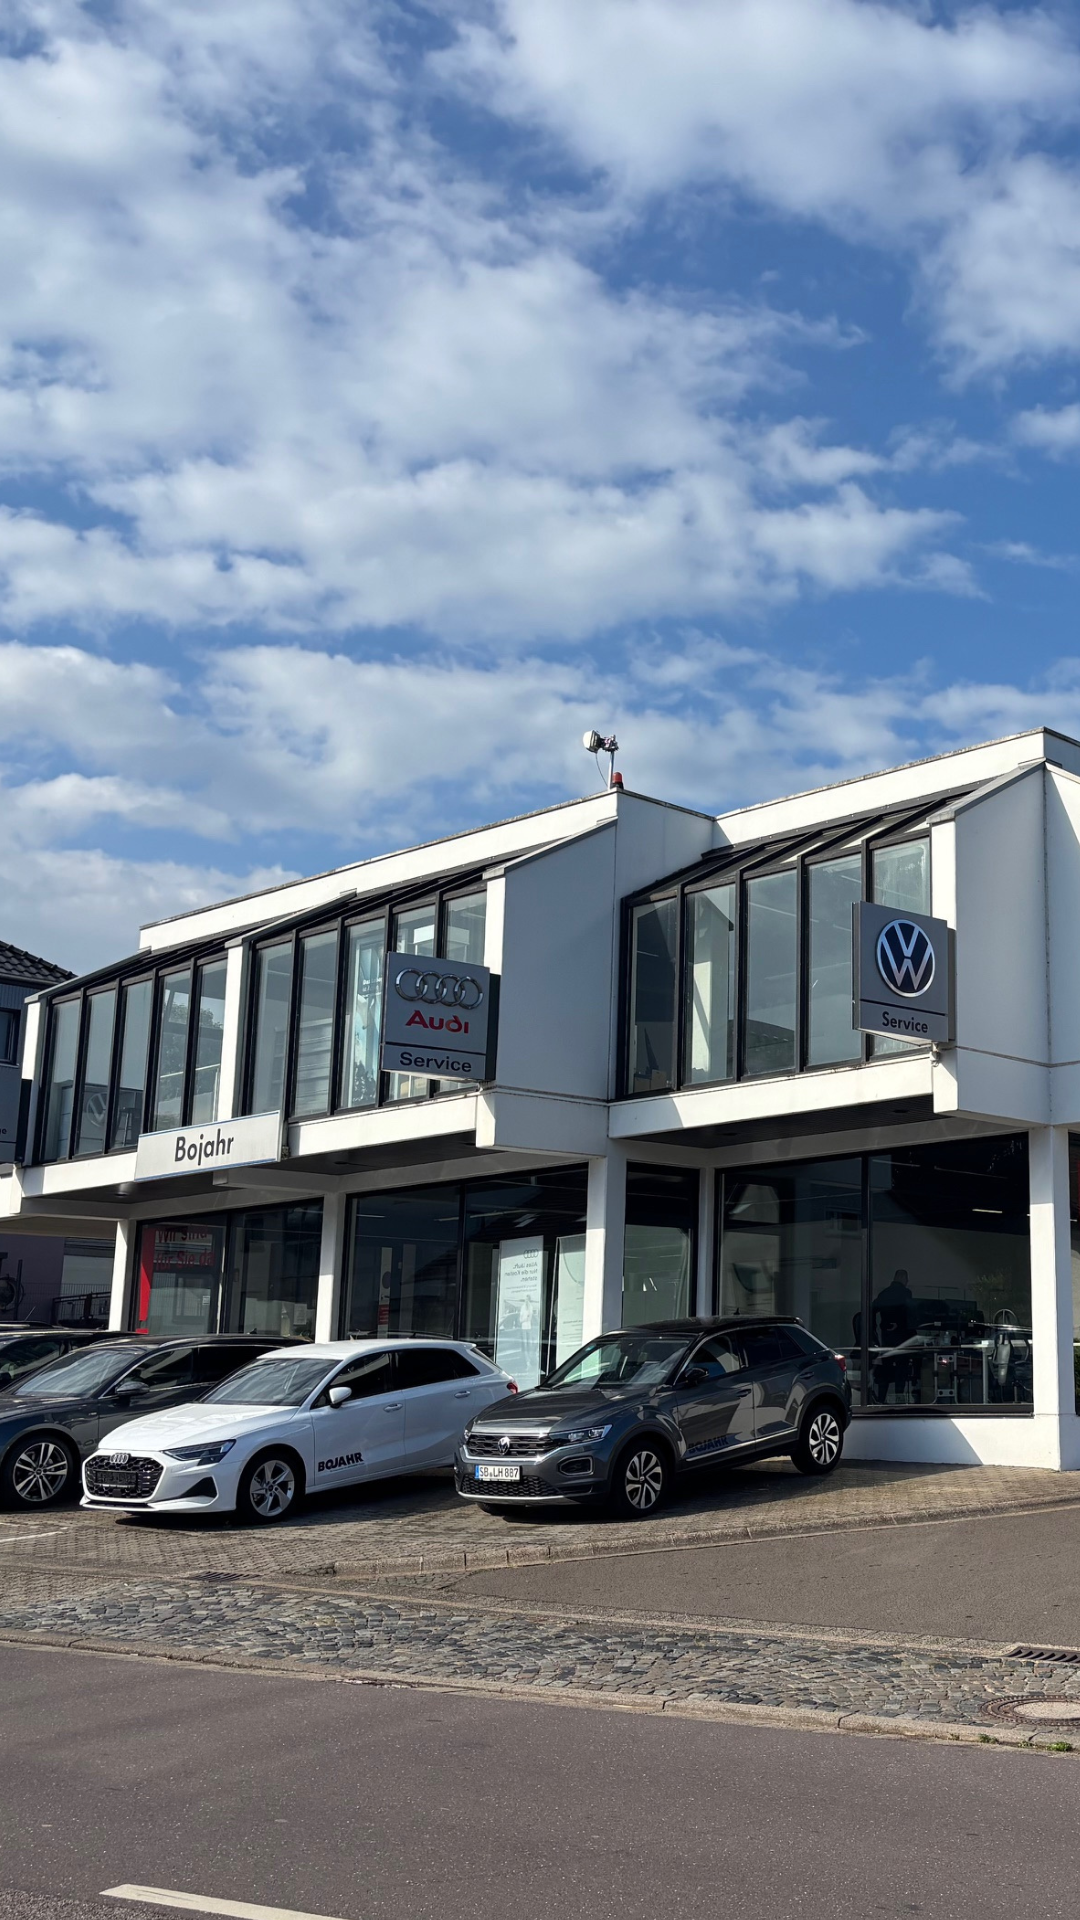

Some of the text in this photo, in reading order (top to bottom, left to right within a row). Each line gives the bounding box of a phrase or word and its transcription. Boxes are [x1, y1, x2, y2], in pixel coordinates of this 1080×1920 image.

[405, 1010, 469, 1034] Audi
[882, 1011, 928, 1033] Service
[400, 1051, 472, 1072] Service
[174, 1128, 234, 1166] Bojahr
[317, 1452, 364, 1472] BOJAHR
